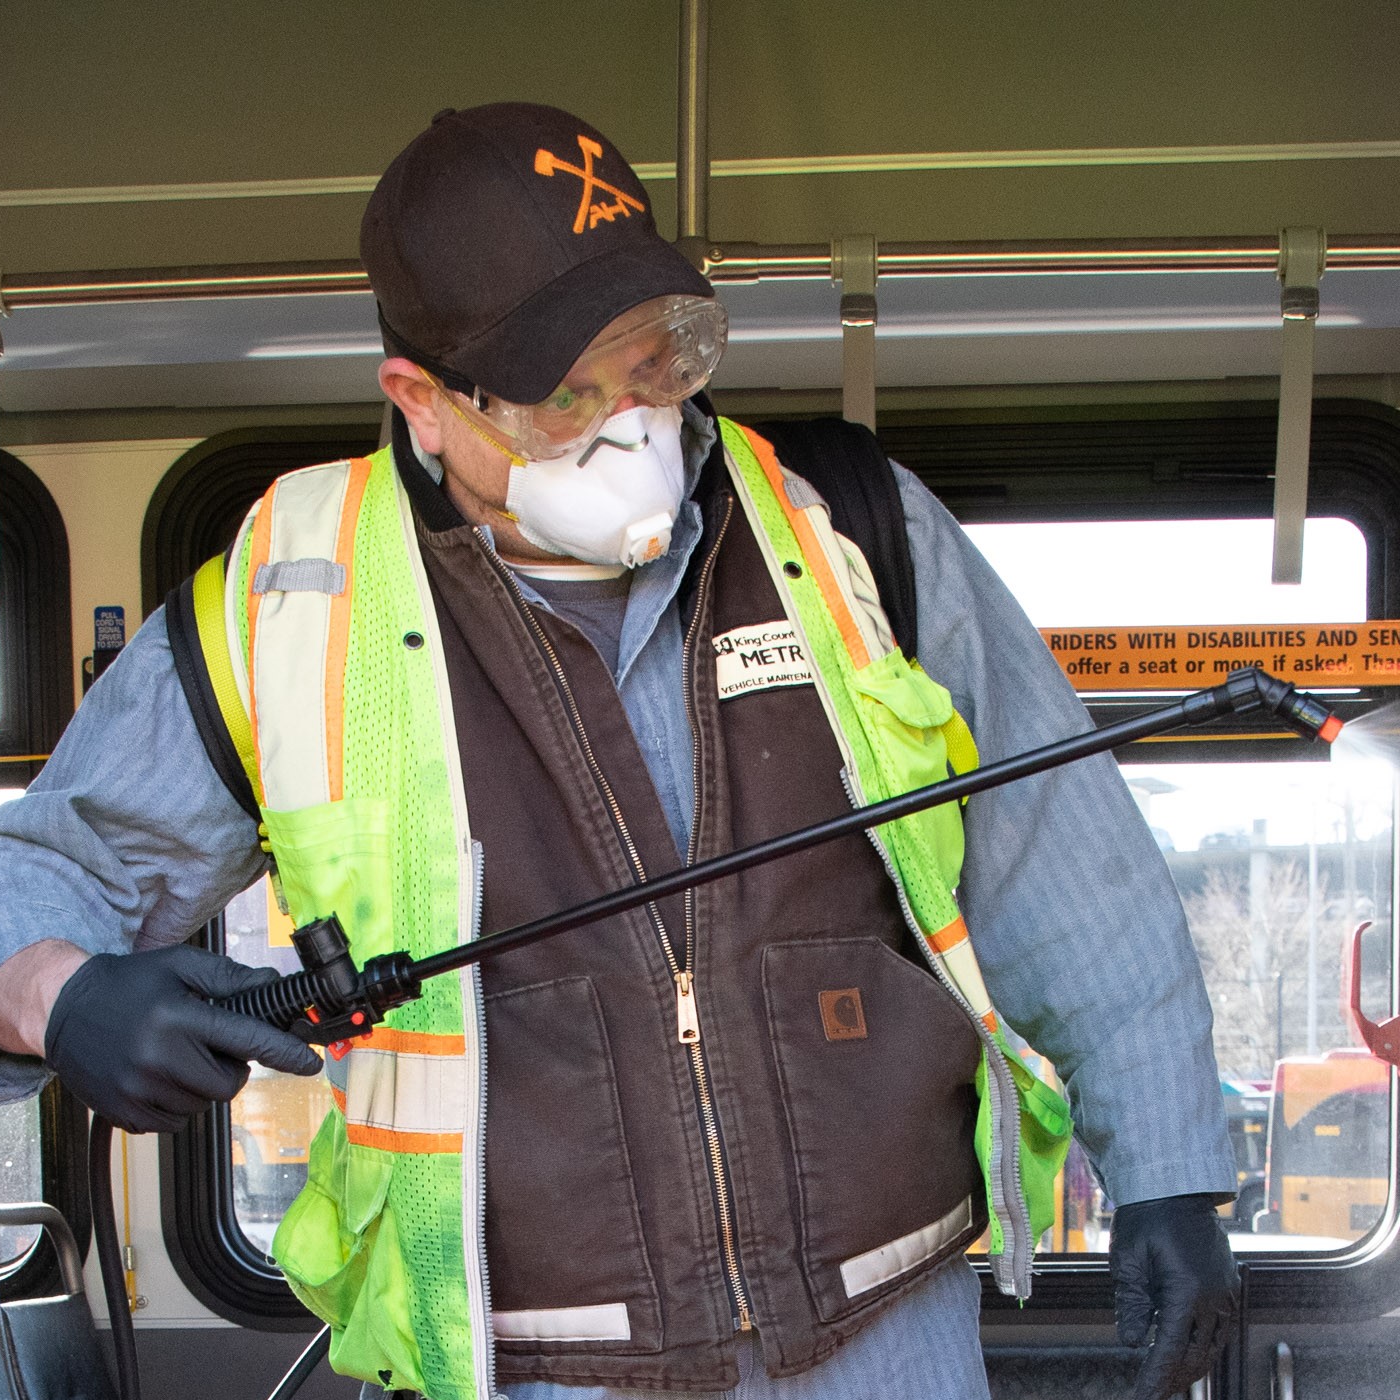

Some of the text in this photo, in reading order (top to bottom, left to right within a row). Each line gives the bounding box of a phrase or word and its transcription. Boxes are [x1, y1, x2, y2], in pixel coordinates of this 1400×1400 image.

[734, 636, 762, 646] King
[1050, 633, 1117, 650] RIDERS
[1128, 632, 1176, 649] WITH
[1187, 630, 1306, 648] DISABILITIES
[1316, 629, 1358, 647] AND
[1066, 657, 1112, 675] offer
[1119, 661, 1130, 674] a
[1138, 658, 1177, 674] seat
[1185, 659, 1205, 673] or
[1273, 654, 1286, 672] if
[721, 676, 765, 694] VEHICLE
